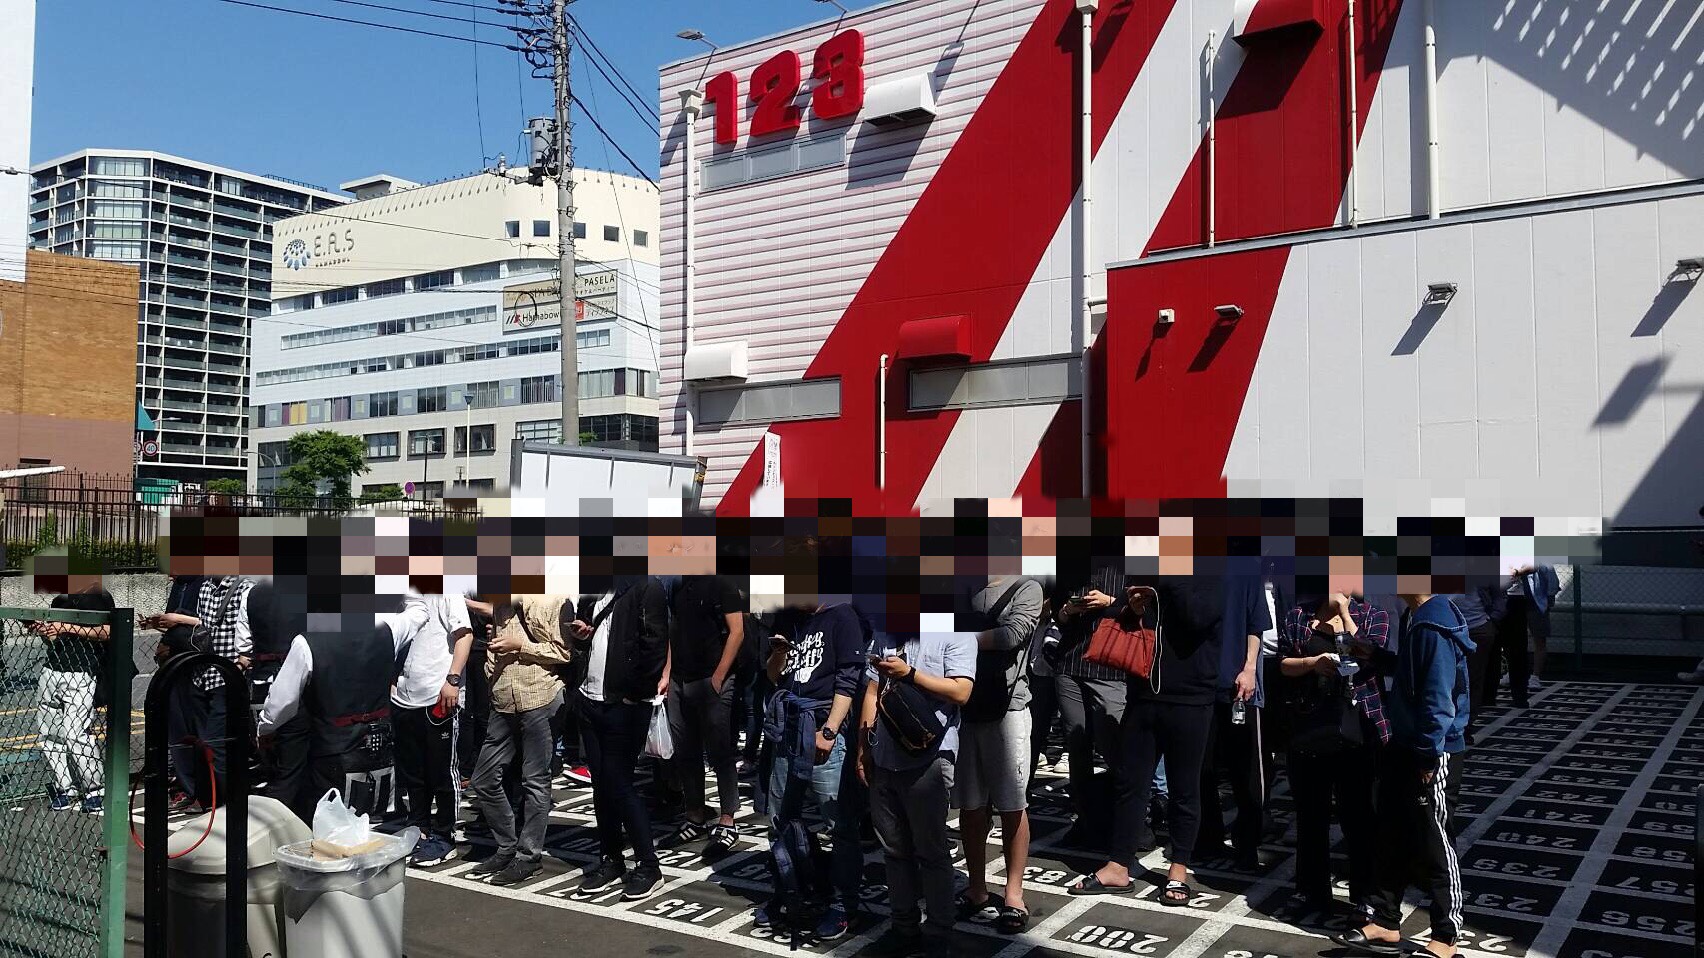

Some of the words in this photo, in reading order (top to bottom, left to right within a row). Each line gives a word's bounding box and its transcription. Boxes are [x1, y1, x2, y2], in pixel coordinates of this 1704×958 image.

[705, 29, 864, 144] 123
[584, 274, 615, 287] PASELA
[1535, 790, 1607, 803] 242
[1524, 809, 1593, 823] 241
[1473, 858, 1560, 878] 239
[644, 899, 723, 923] 145
[1071, 926, 1169, 953] 200
